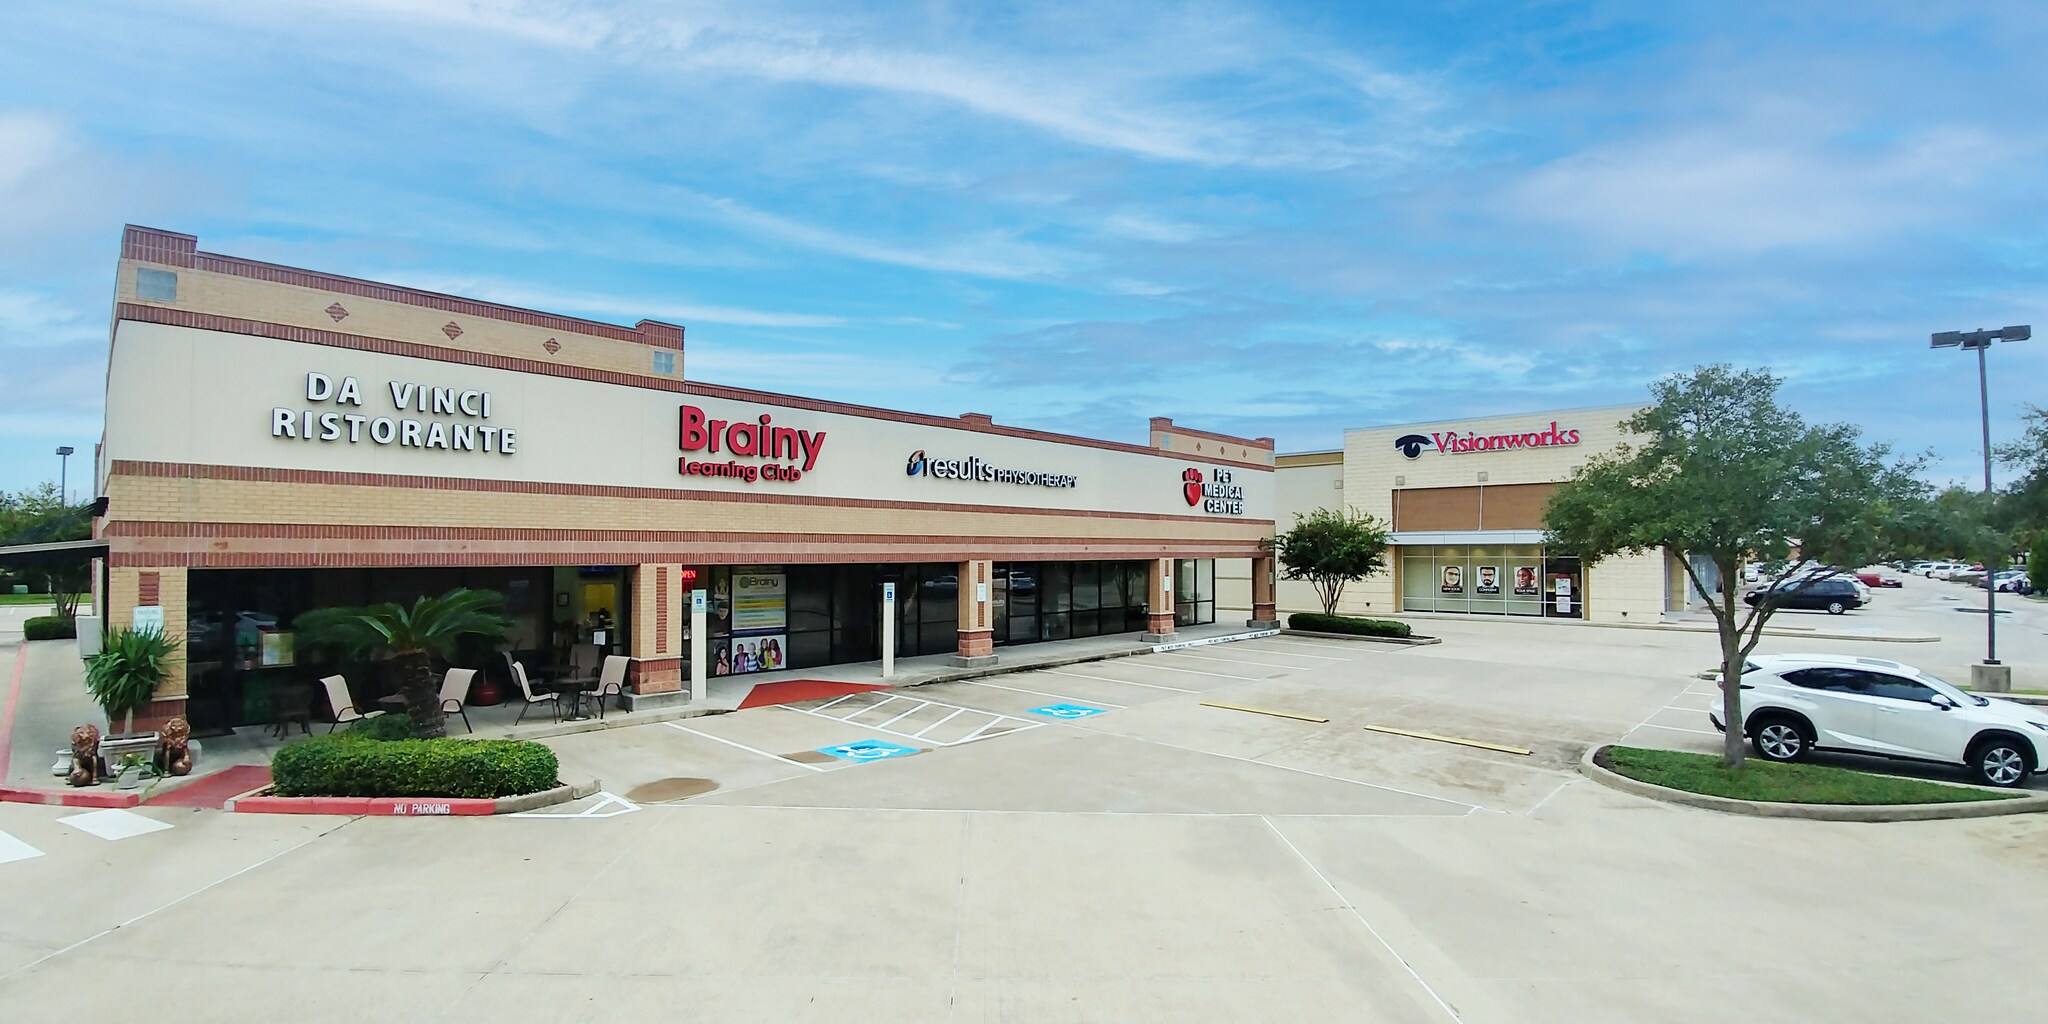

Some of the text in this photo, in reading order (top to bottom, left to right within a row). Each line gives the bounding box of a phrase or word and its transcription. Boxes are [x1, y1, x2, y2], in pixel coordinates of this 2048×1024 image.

[307, 371, 492, 419] DA VINCI
[271, 407, 517, 454] RISTORANTE
[679, 404, 827, 472] Brainy
[1431, 421, 1581, 454] Visionworks
[679, 456, 802, 484] Learning Club
[924, 455, 1079, 488] results PHYSIOTHERAPY
[1214, 468, 1235, 483] PET
[1202, 483, 1246, 500] MEDICAL
[1204, 499, 1244, 515] CENTER
[749, 576, 779, 588] Brainy
[393, 803, 450, 815] NO PARKING
